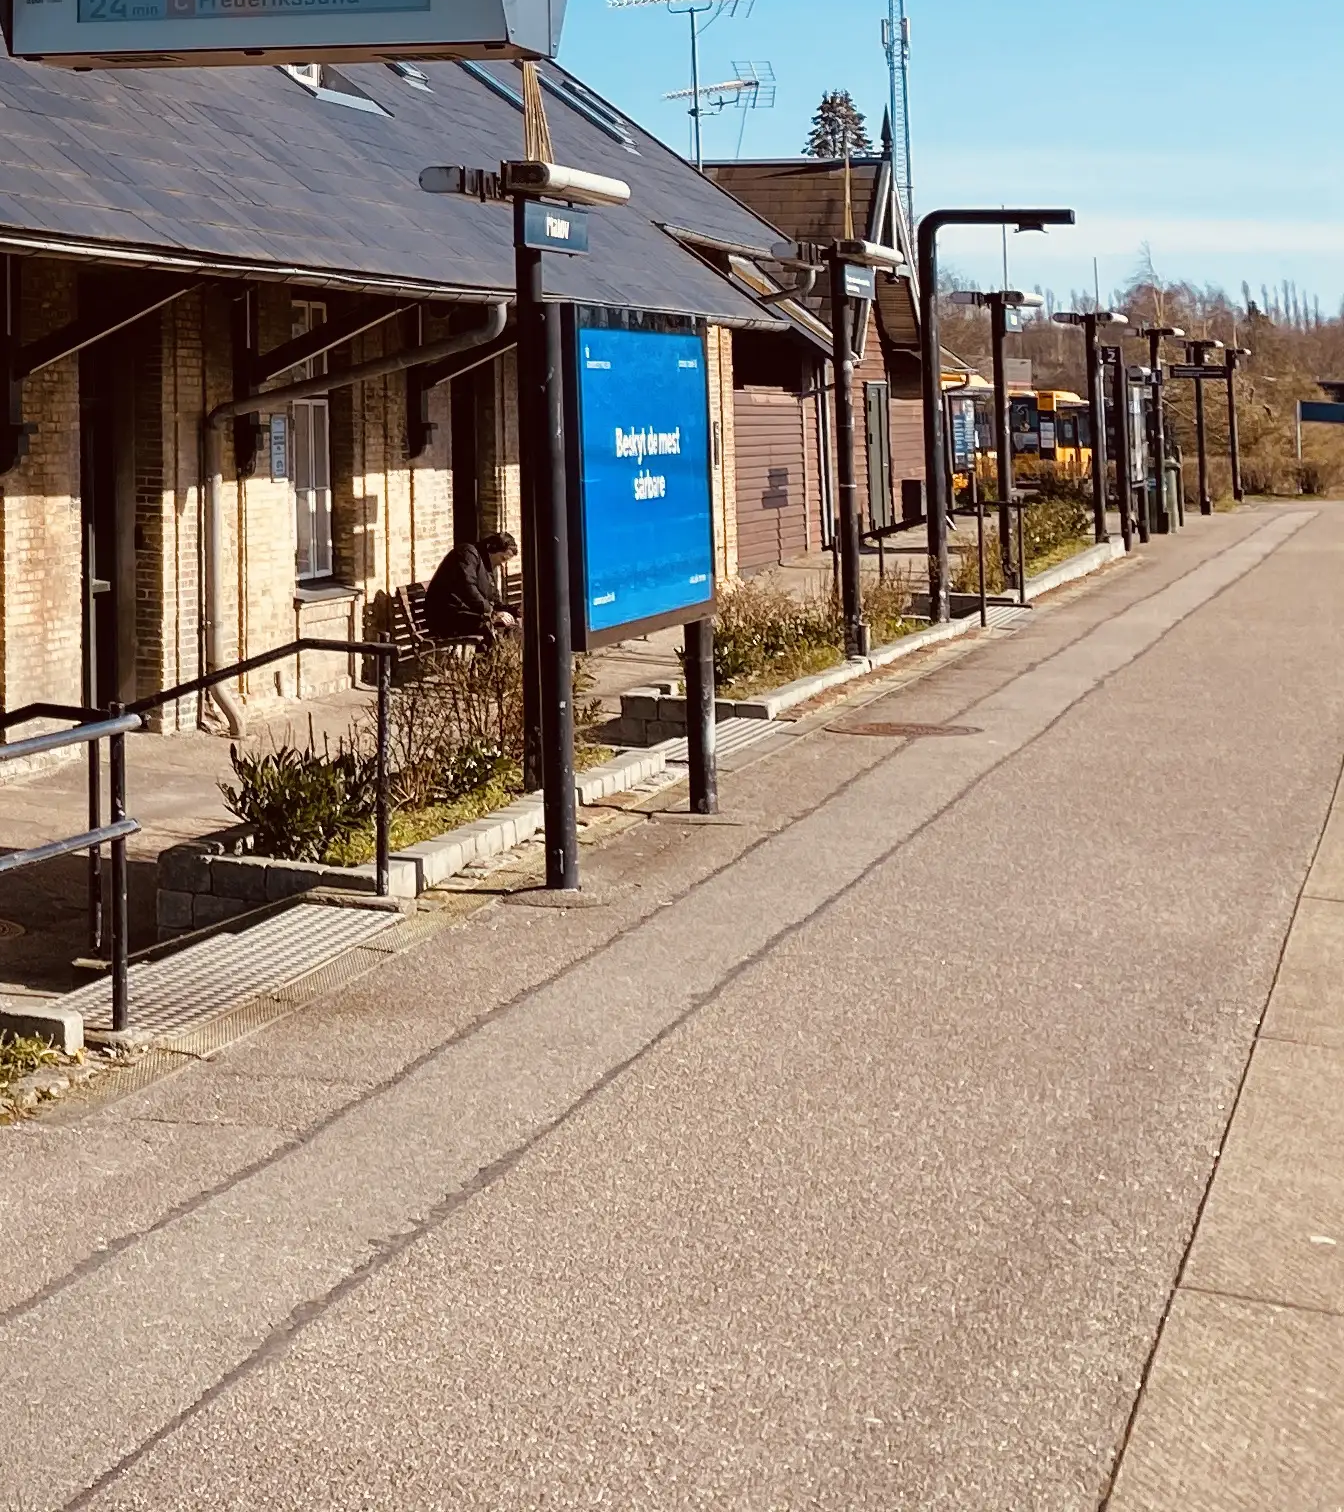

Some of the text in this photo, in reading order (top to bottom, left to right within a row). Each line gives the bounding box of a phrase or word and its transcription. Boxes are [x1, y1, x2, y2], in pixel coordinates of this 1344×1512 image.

[131, 4, 159, 17] min
[615, 425, 647, 466] Beskyt
[647, 425, 658, 456] de
